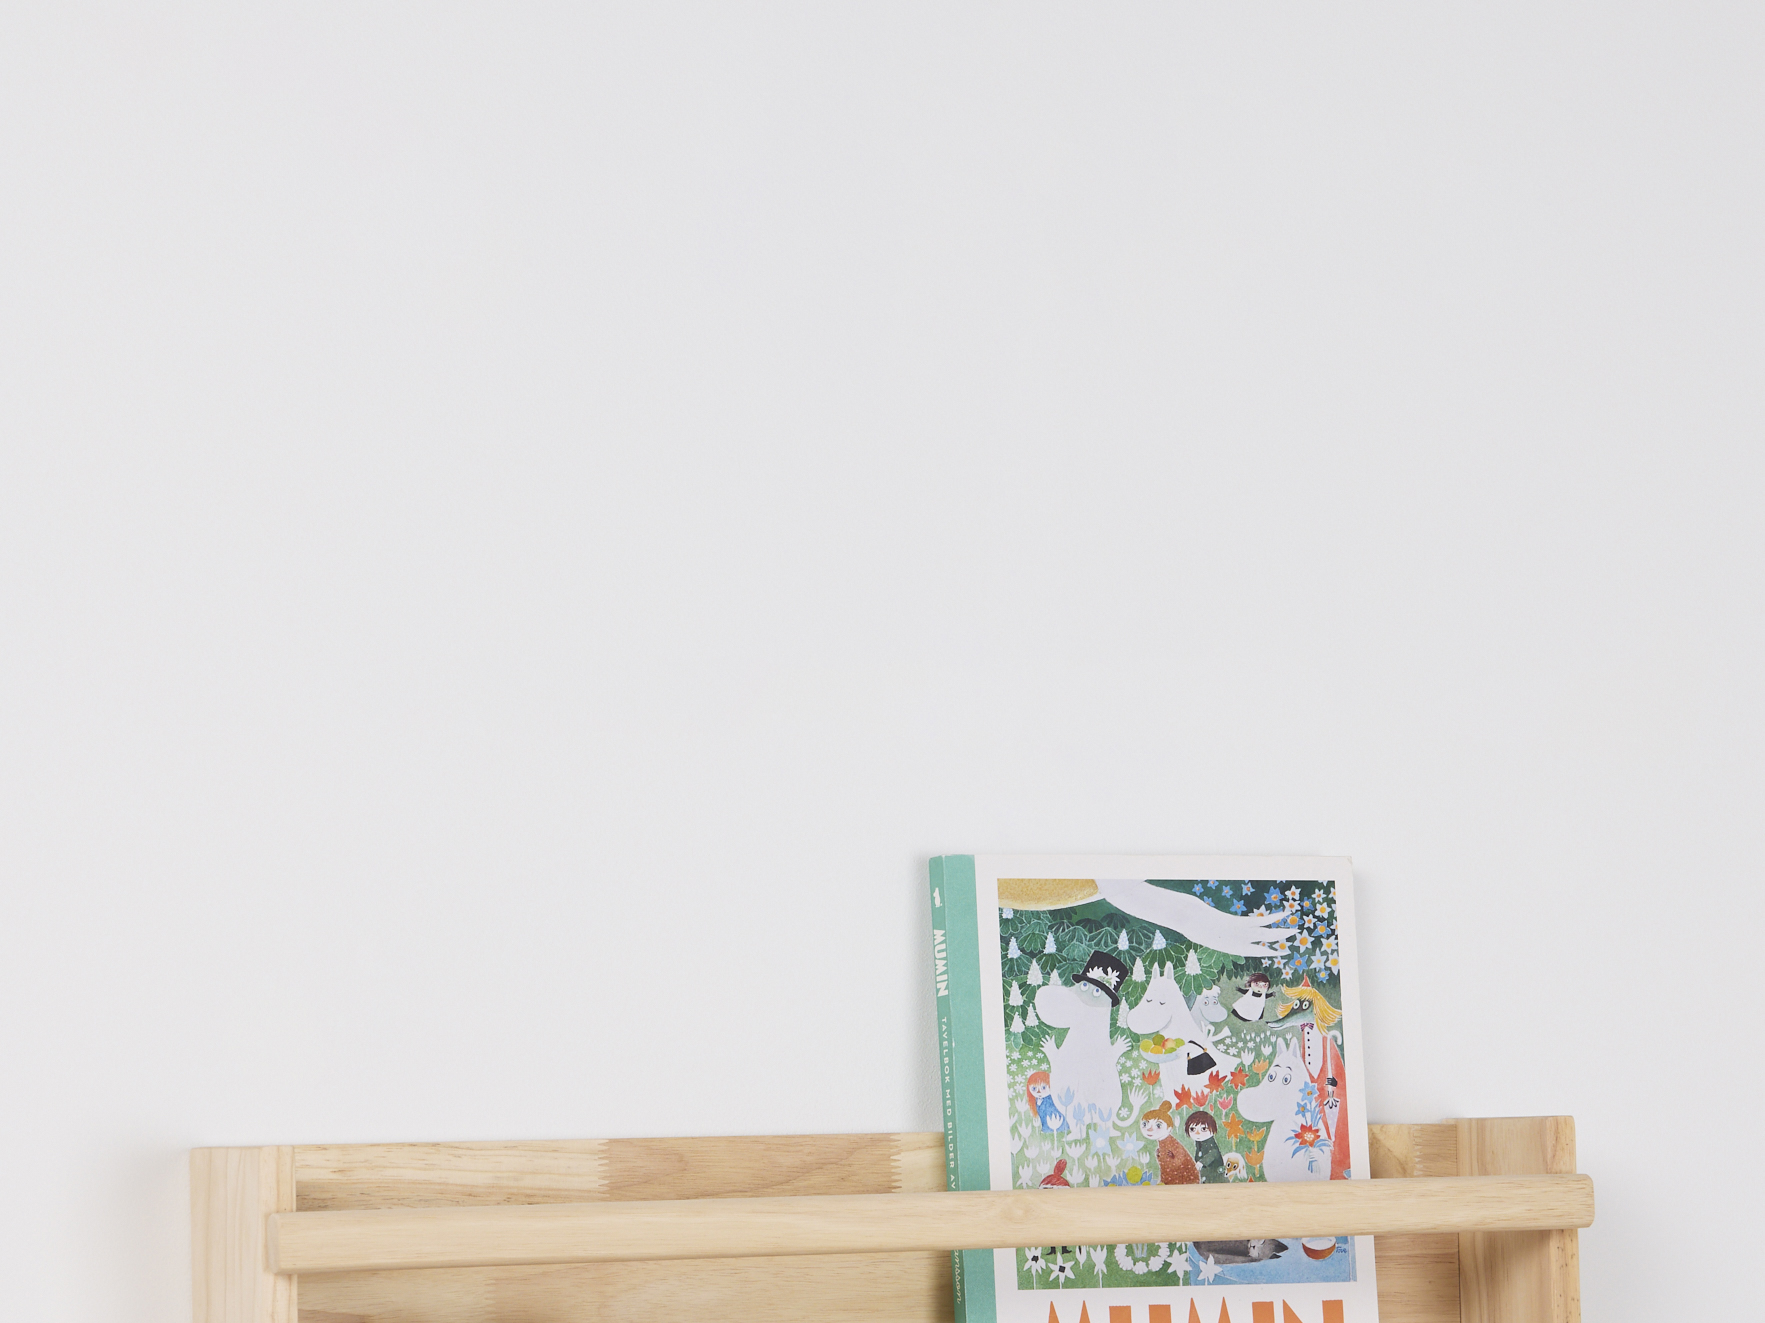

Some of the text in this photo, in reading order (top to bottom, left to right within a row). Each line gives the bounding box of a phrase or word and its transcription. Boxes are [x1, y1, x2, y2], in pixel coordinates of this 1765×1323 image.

[933, 929, 949, 998] MUMIN
[941, 1016, 950, 1083] TAVELBOK
[947, 1121, 955, 1168] BILDER
[950, 1174, 956, 1189] AV
